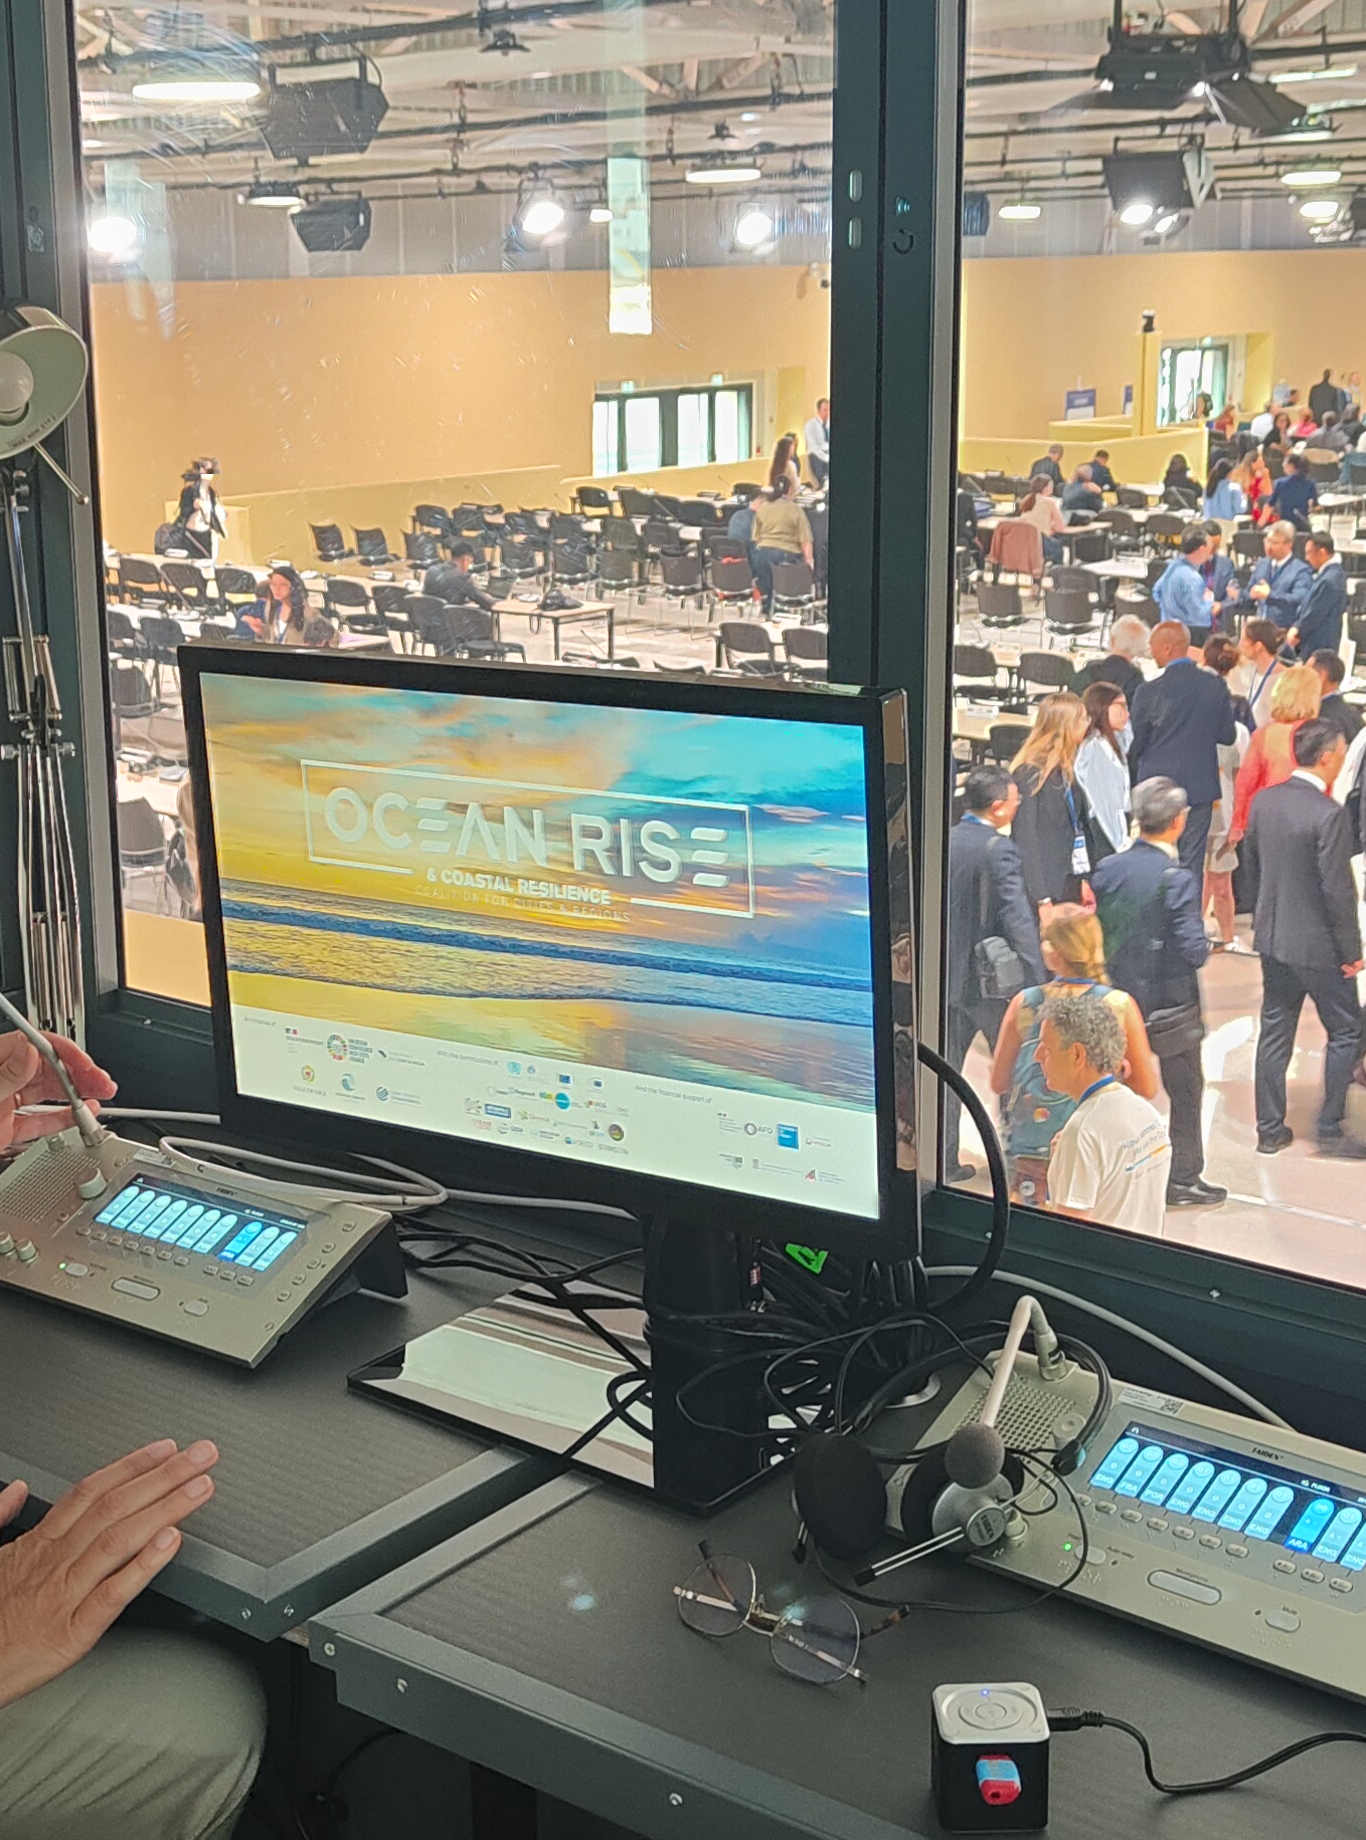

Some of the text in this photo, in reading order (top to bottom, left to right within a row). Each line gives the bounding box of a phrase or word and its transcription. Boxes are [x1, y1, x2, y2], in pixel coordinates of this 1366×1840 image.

[324, 786, 730, 888] OCEAN RISE
[427, 868, 612, 906] & COASTAL RESILIENCE
[414, 884, 480, 903] COALITION
[484, 894, 509, 908] FOR
[513, 897, 554, 912] CITIES
[573, 904, 631, 923] REGIONS
[1120, 1481, 1138, 1491] FRA
[1144, 1489, 1165, 1500] POR
[1170, 1498, 1190, 1507] ENG
[1196, 1507, 1216, 1517] ENG
[1222, 1515, 1242, 1525] ENG
[1249, 1523, 1269, 1534] ENG
[1288, 1538, 1309, 1550] ARA
[1316, 1545, 1337, 1556] ENG
[1345, 1554, 1366, 1565] ENG
